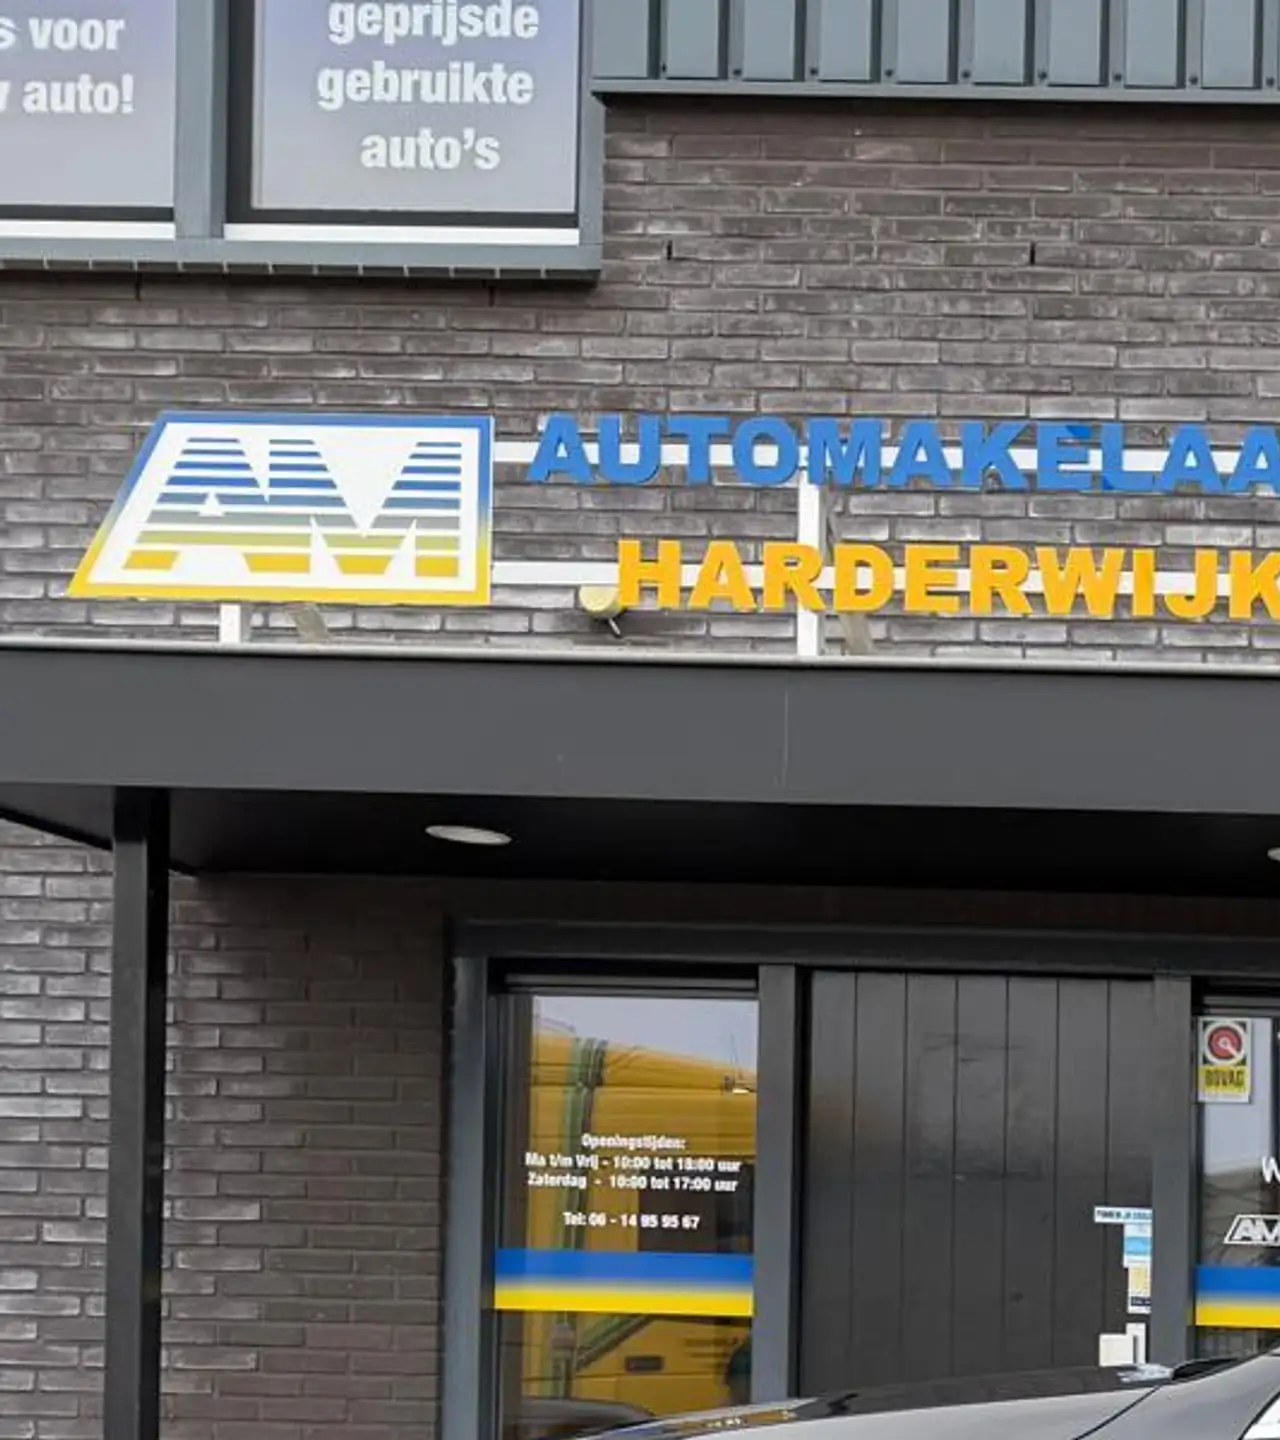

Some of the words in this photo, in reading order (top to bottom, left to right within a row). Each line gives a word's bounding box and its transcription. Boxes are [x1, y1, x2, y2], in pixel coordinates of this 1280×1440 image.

[28, 17, 126, 51] voor
[328, 0, 540, 46] geprijsde
[22, 73, 135, 114] auto!
[317, 60, 535, 111] gebruikte
[360, 127, 500, 170] auto's
[121, 437, 462, 580] AM
[581, 1133, 687, 1151] Openingstijden:
[527, 1171, 587, 1189] Zaterdag
[650, 1176, 670, 1190] tot
[673, 1177, 711, 1192] 17:00
[714, 1180, 739, 1193] uur
[654, 1157, 673, 1171] tot
[717, 1160, 742, 1173] uur
